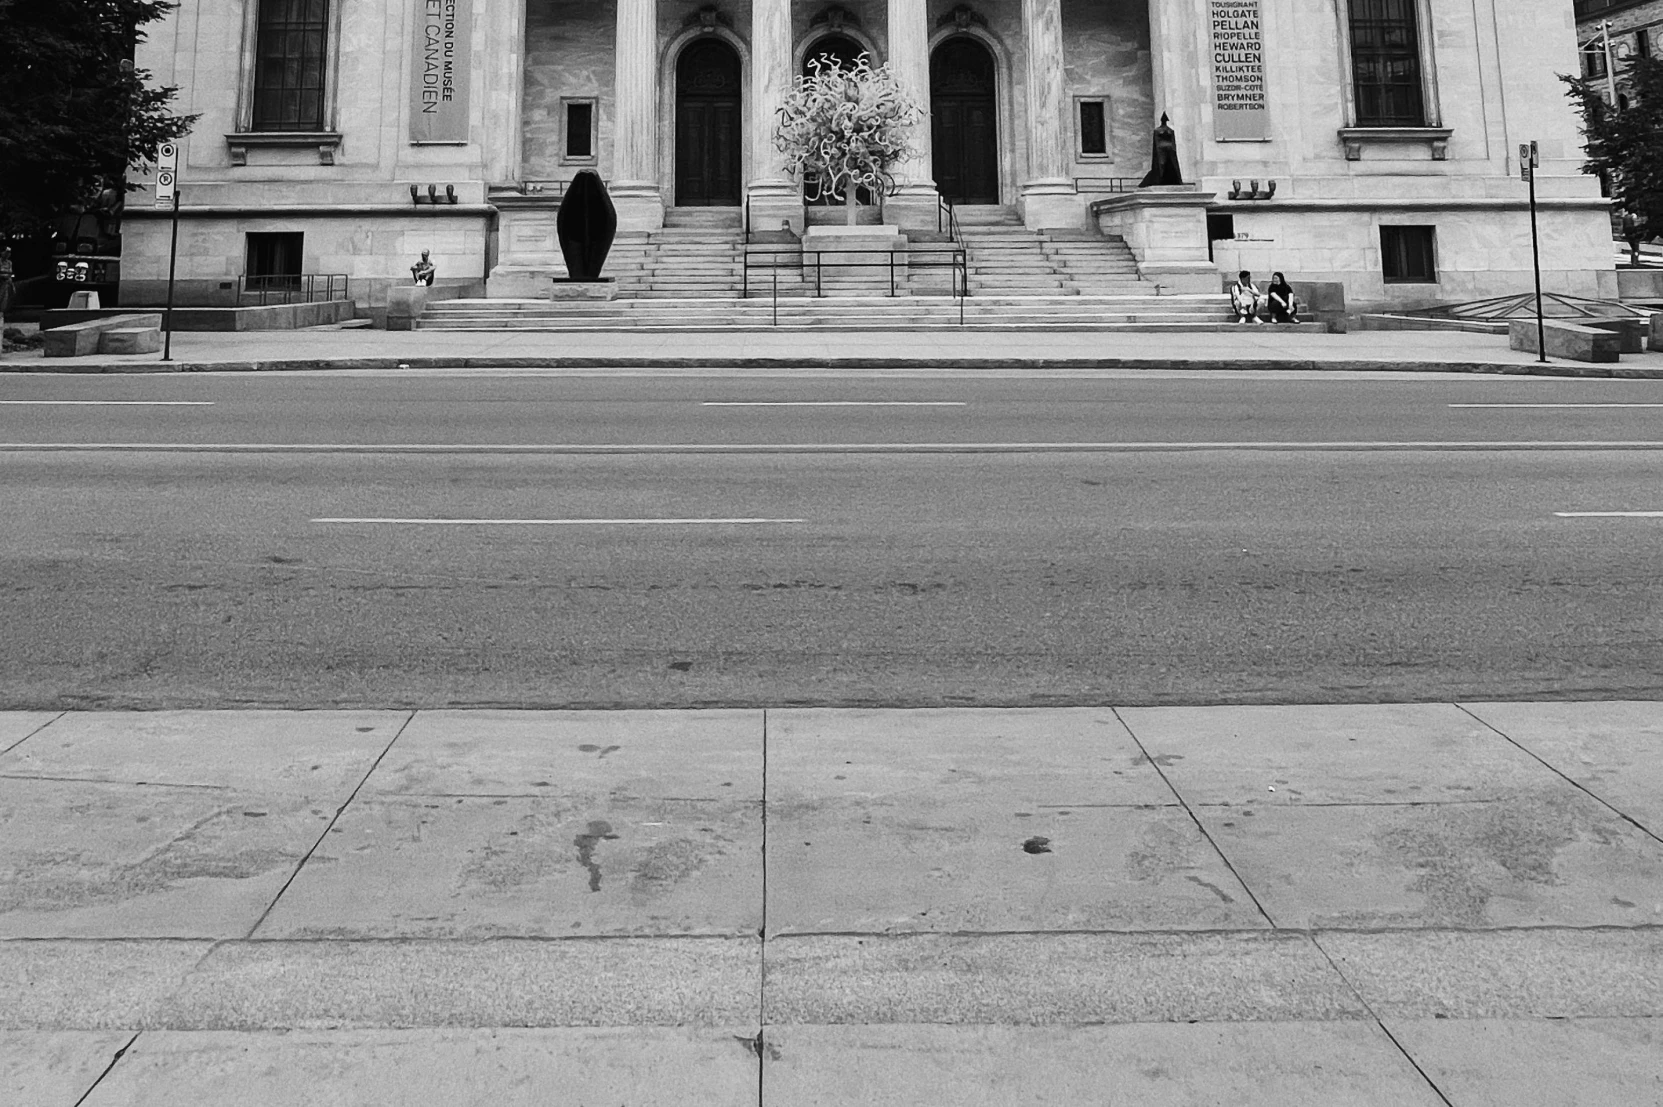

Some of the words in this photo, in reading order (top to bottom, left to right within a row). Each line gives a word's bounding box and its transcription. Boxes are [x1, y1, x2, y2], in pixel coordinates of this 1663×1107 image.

[426, 0, 441, 20] ET
[1212, 10, 1258, 18] HOLGATE
[1213, 20, 1259, 30] PELLAN
[1213, 32, 1260, 40] RIOPELLE
[444, 42, 454, 57] DU
[1214, 42, 1261, 51] HEWARD
[1215, 53, 1261, 63] CULLEN
[422, 25, 440, 113] CANADIEN
[1215, 65, 1262, 73] KILLIKTEE
[442, 62, 455, 101] MUSÉE
[1217, 93, 1264, 101] BRYMNER
